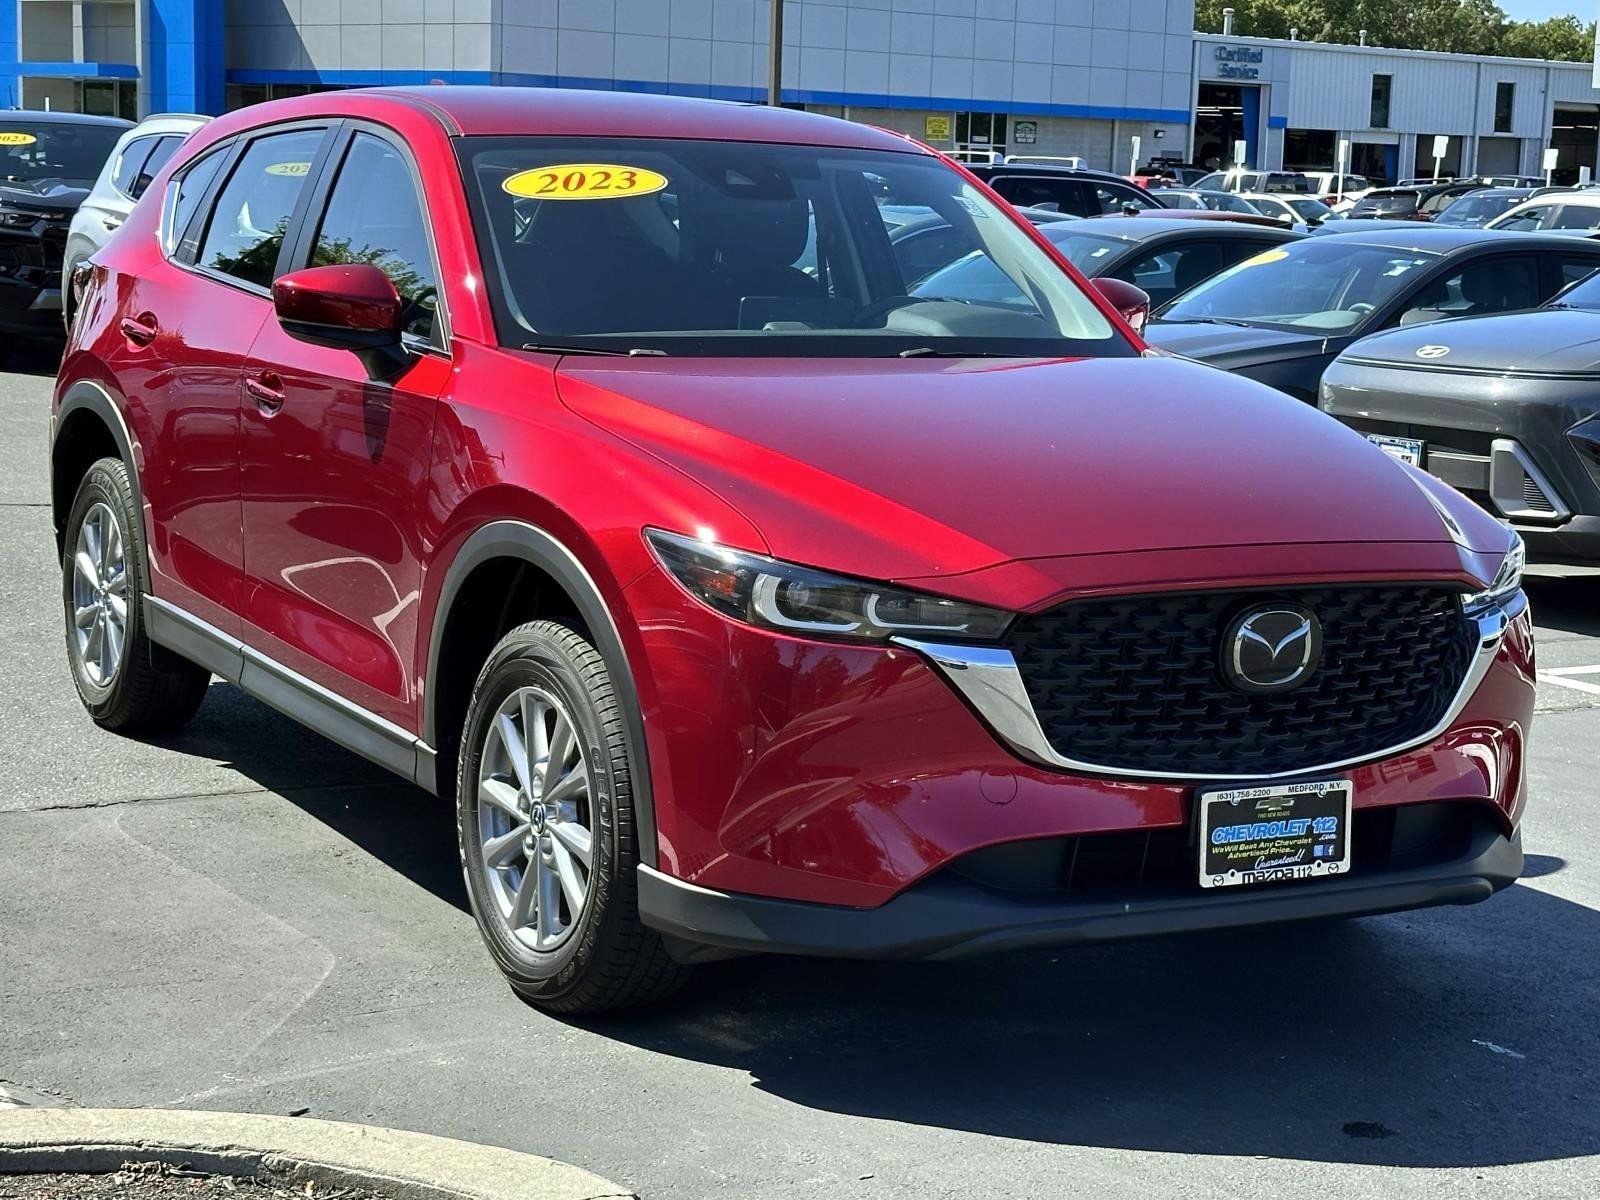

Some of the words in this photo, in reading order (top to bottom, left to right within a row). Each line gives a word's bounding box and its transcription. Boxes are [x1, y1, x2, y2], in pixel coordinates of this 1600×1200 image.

[1215, 46, 1263, 63] Certified
[1219, 63, 1259, 79] Service
[535, 171, 637, 194] 2023
[1237, 789, 1271, 799] 758-2200
[1211, 819, 1311, 844] CHEVROLET
[1313, 816, 1338, 833] 112
[1258, 841, 1274, 849] Any
[1274, 838, 1312, 847] Chevrolet
[1227, 848, 1269, 859] Advertised
[1296, 866, 1313, 879] 112
